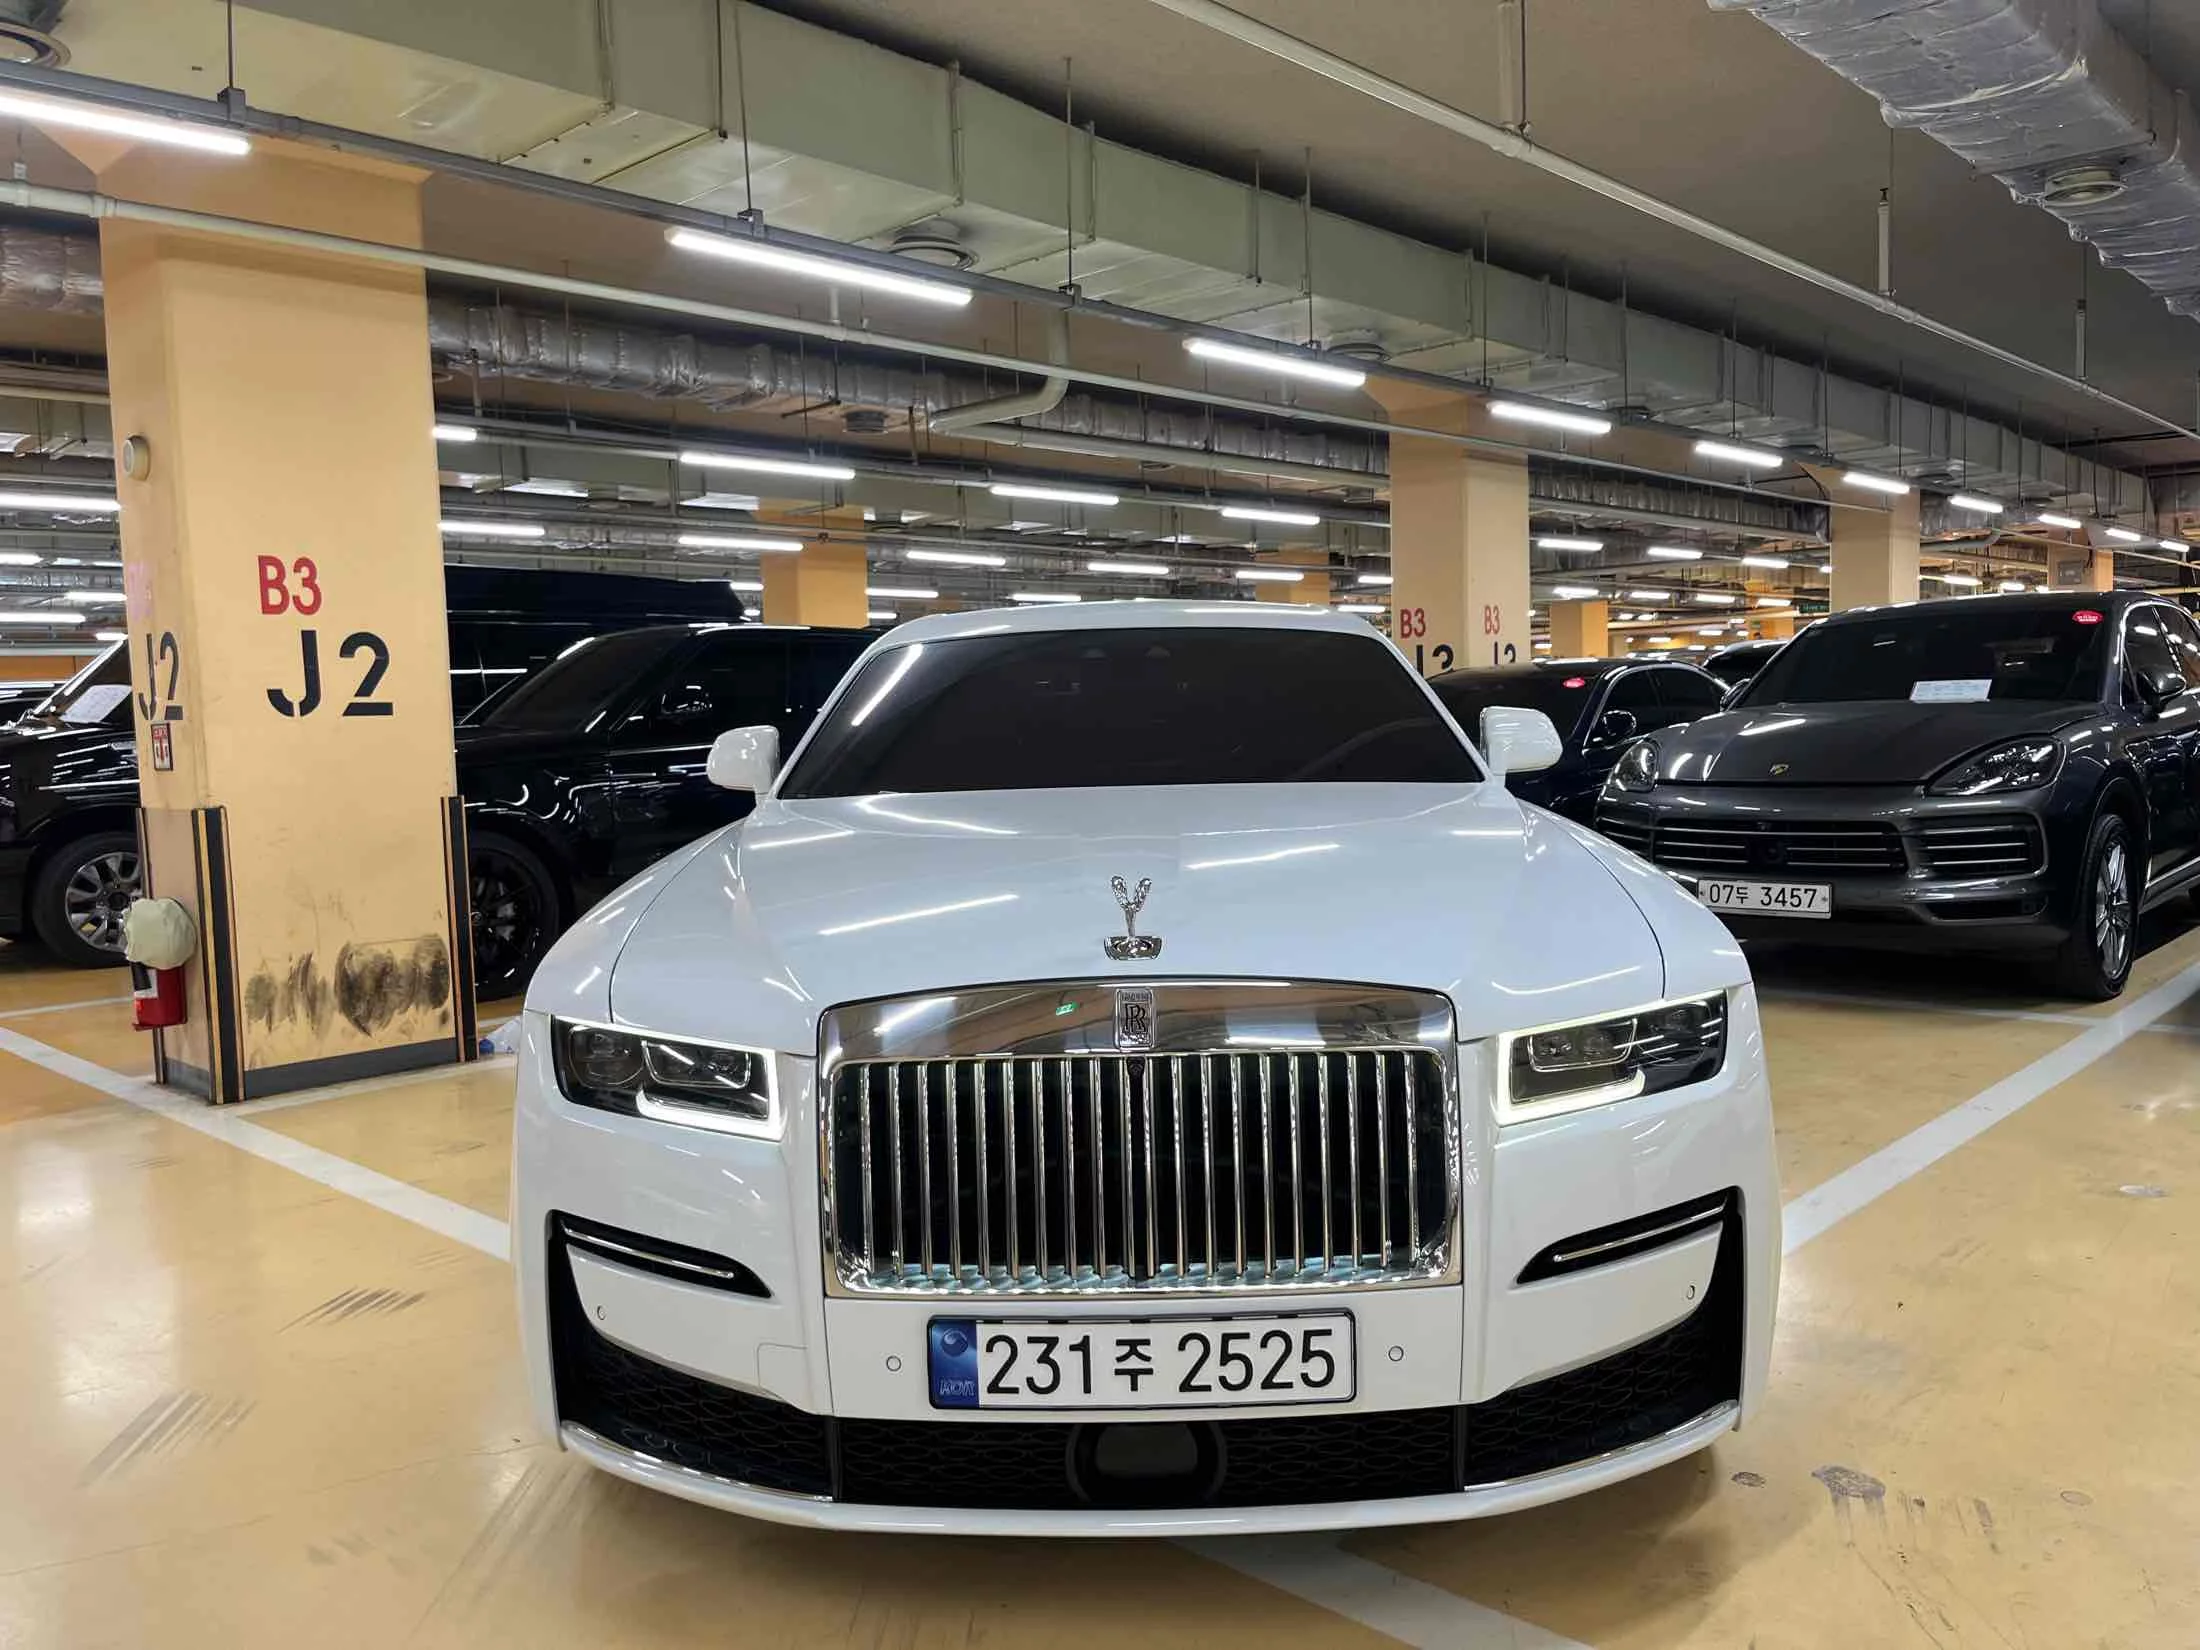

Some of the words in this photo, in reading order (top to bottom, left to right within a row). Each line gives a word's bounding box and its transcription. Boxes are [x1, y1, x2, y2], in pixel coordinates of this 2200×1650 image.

[258, 555, 322, 615] B3
[1400, 607, 1426, 639] B3
[1484, 605, 1500, 635] B3
[138, 631, 184, 720] J2
[267, 629, 394, 717] J2
[1709, 884, 1748, 904] 07두
[1760, 886, 1817, 908] 3457
[1177, 1328, 1336, 1393] 2525
